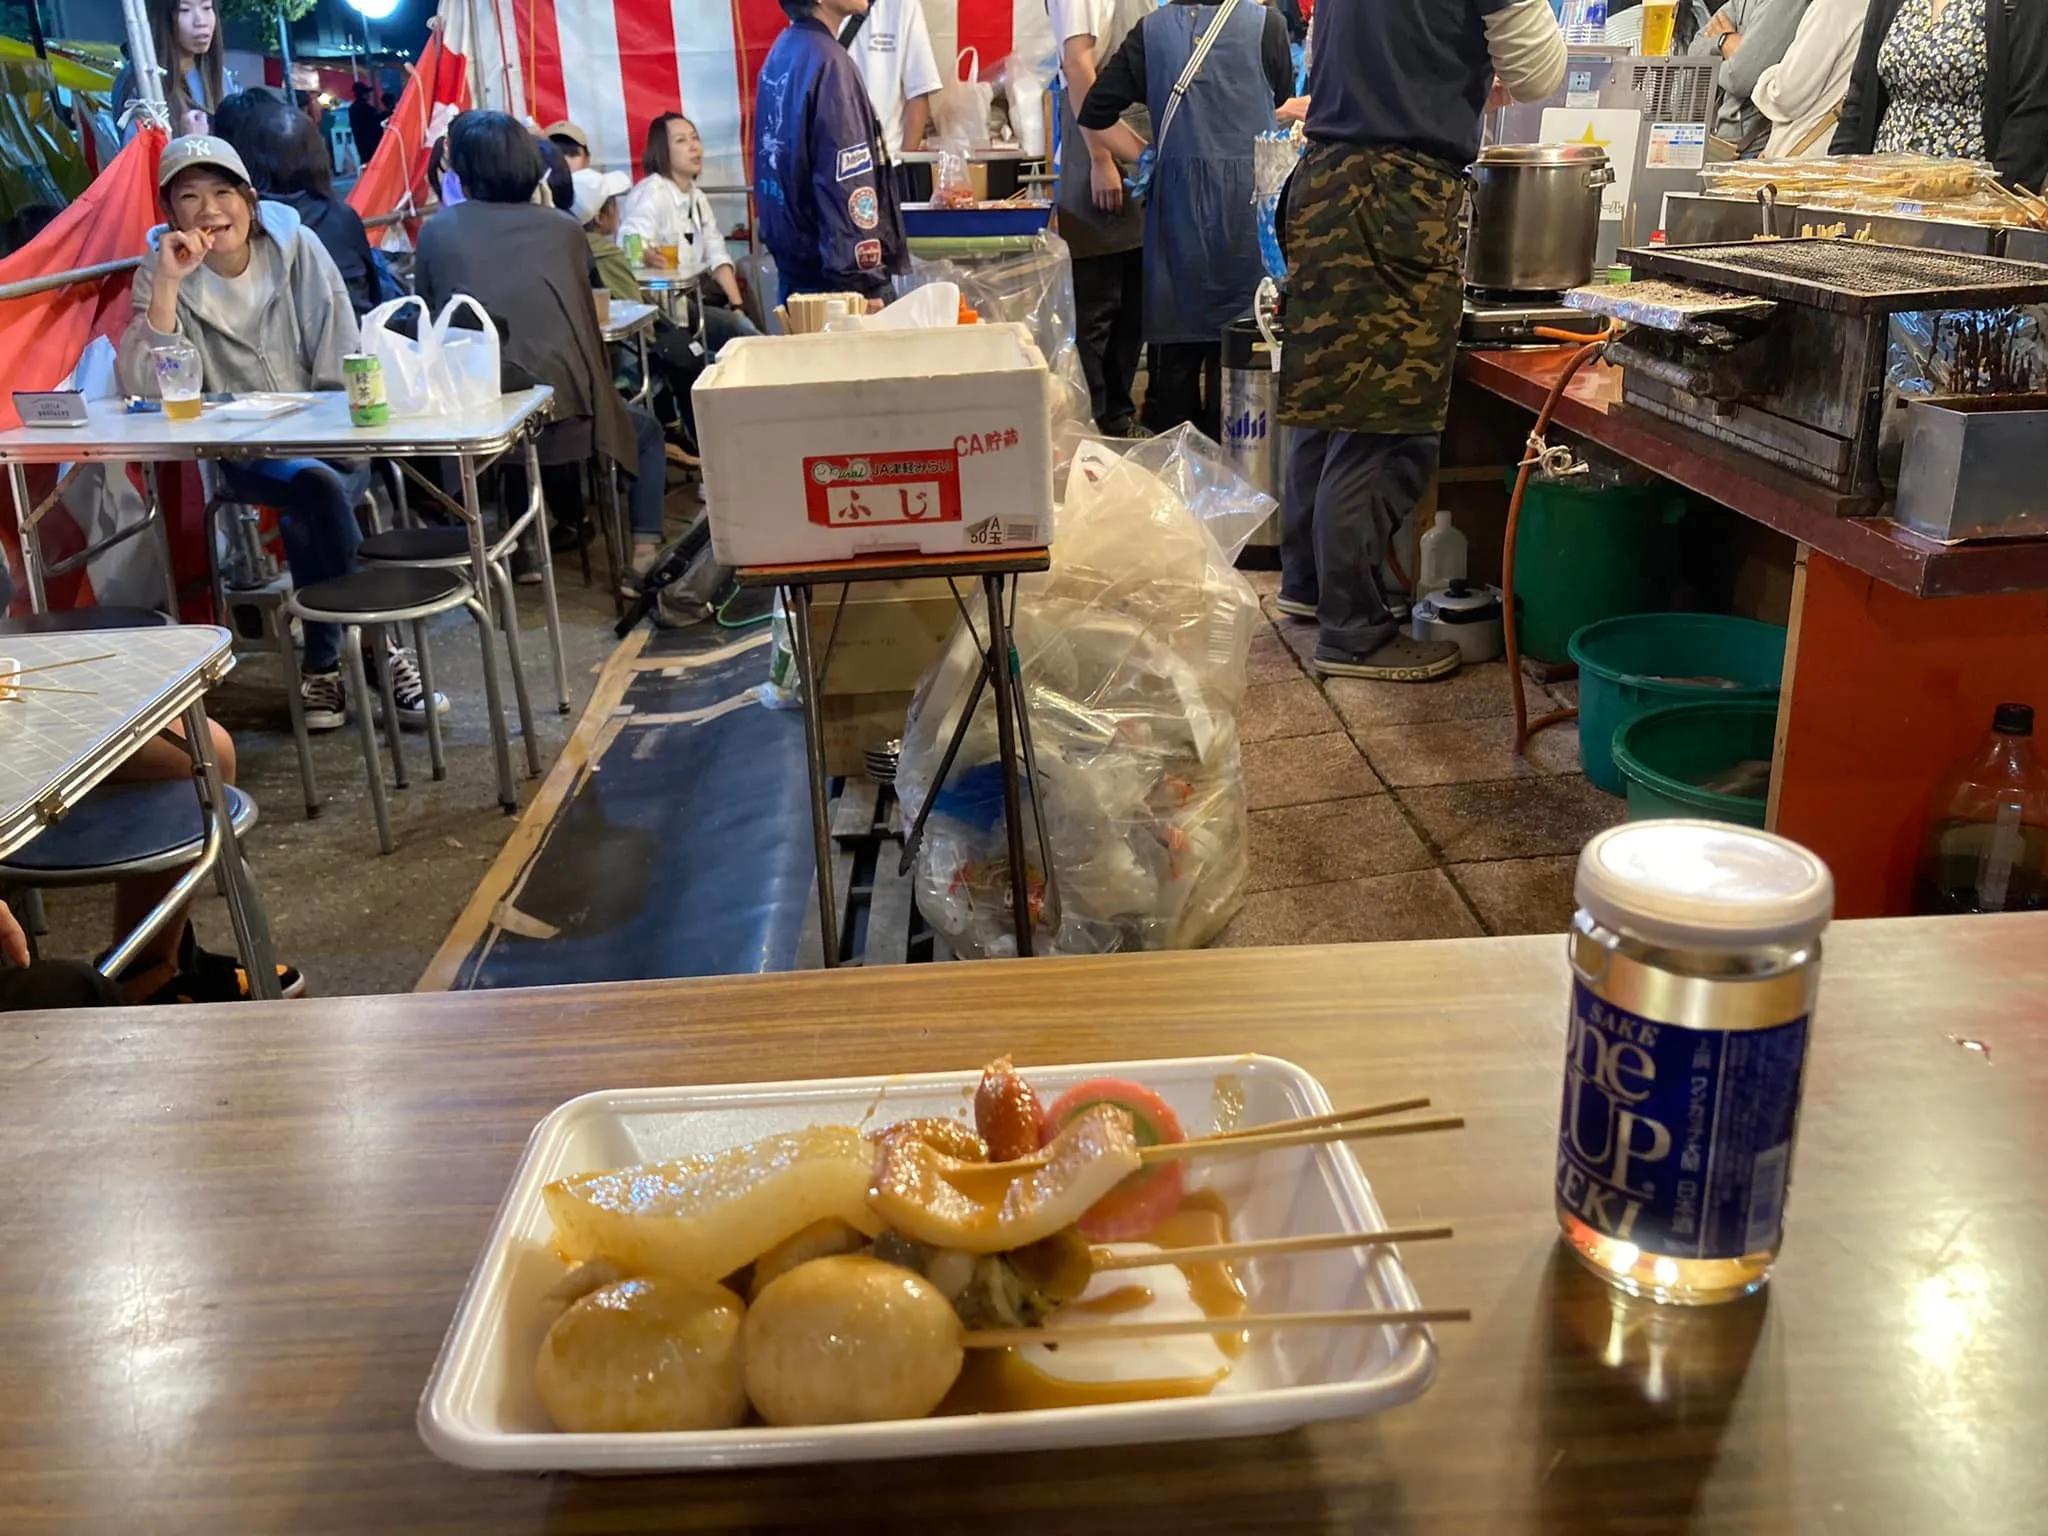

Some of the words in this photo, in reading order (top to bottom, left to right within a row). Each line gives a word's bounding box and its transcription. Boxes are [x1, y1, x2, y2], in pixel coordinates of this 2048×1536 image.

[838, 489, 927, 520] ふじ
[1379, 667, 1431, 679] crocs
[1590, 1002, 1660, 1048] SAKE
[1562, 1068, 1672, 1198] UP
